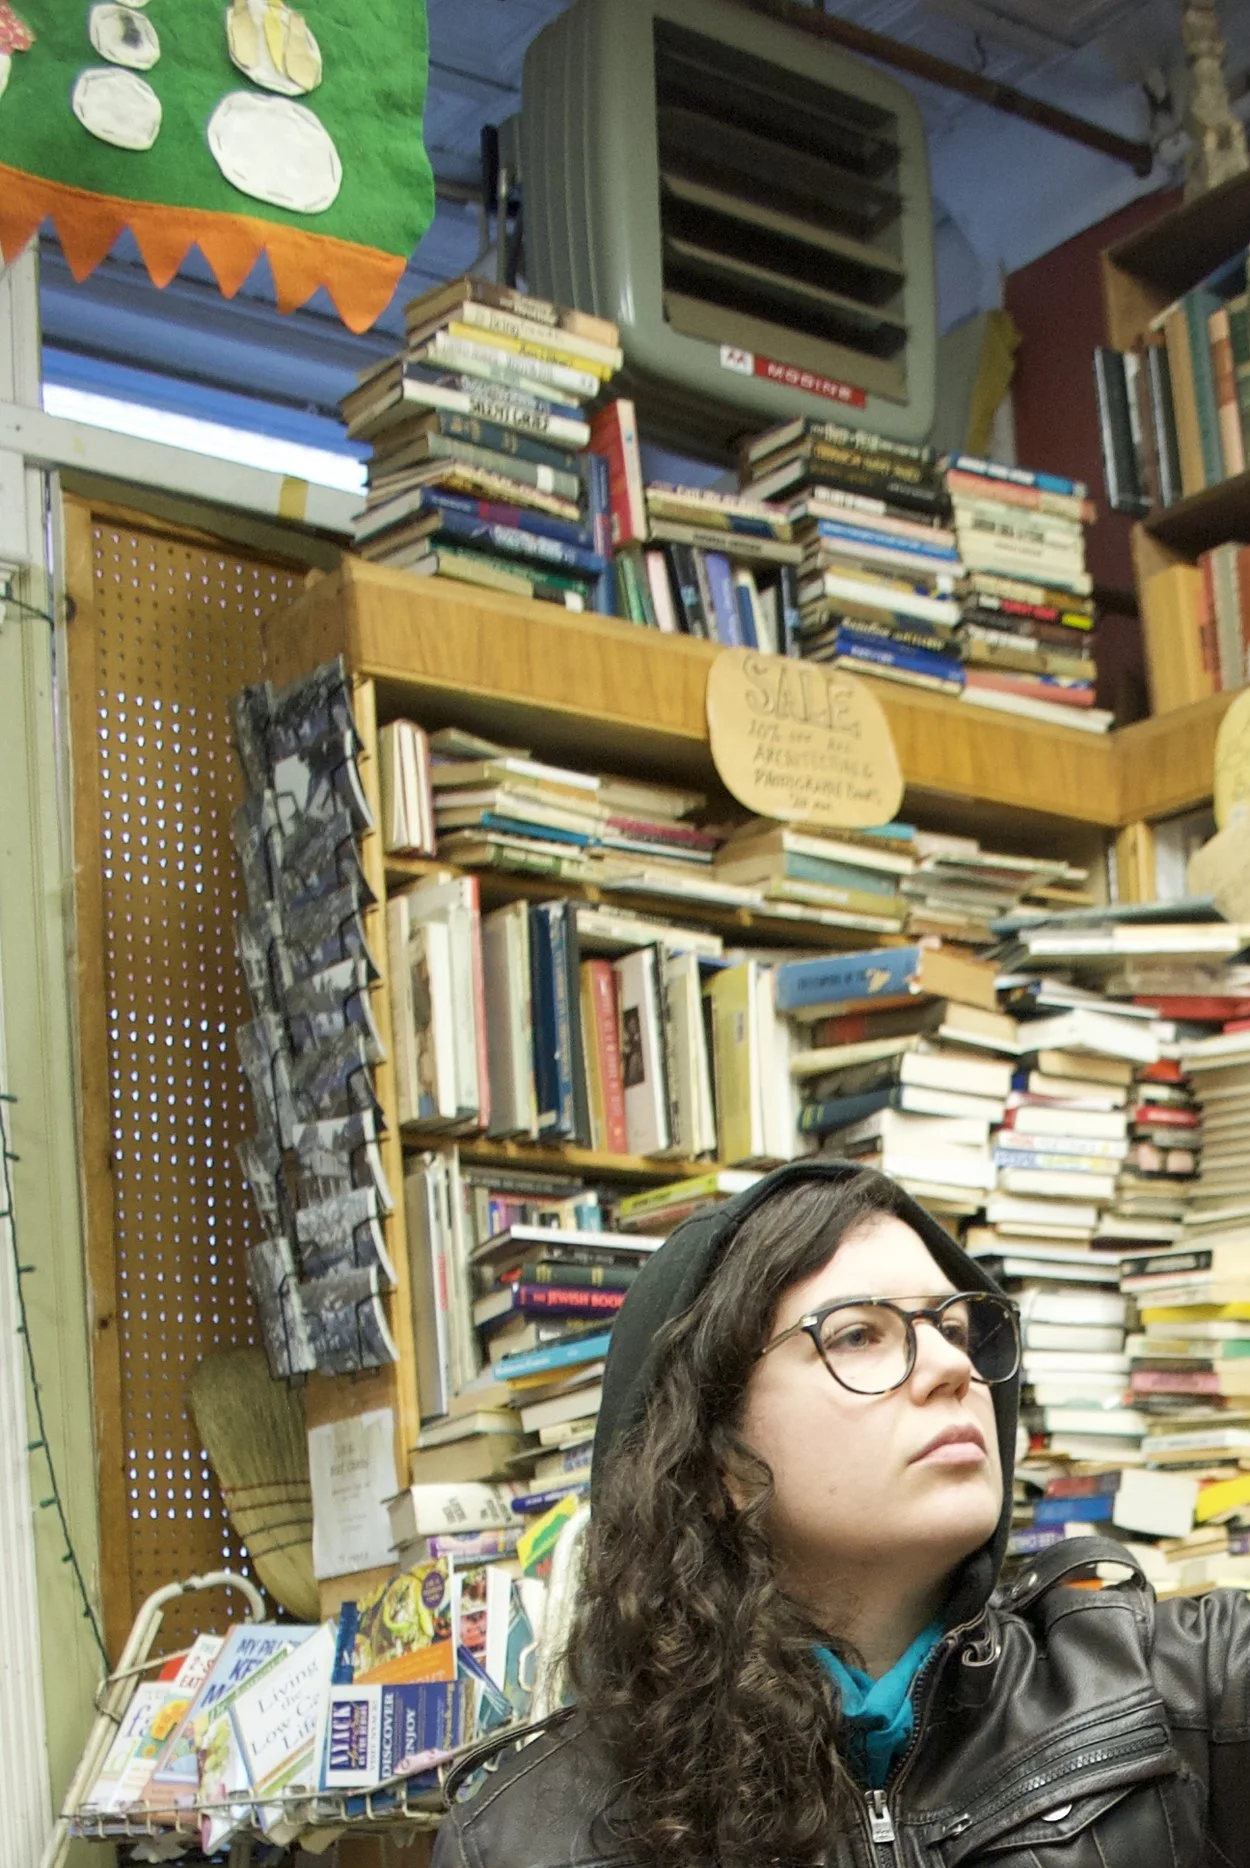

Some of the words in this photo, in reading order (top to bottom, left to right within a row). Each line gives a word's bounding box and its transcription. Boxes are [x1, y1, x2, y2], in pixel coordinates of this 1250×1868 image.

[743, 655, 862, 740] SALE
[547, 1288, 590, 1307] JEWISH
[257, 1657, 319, 1715] Living
[252, 1717, 291, 1757] Low
[331, 1704, 351, 1766] NYACK
[381, 1692, 394, 1779] DISCOVER
